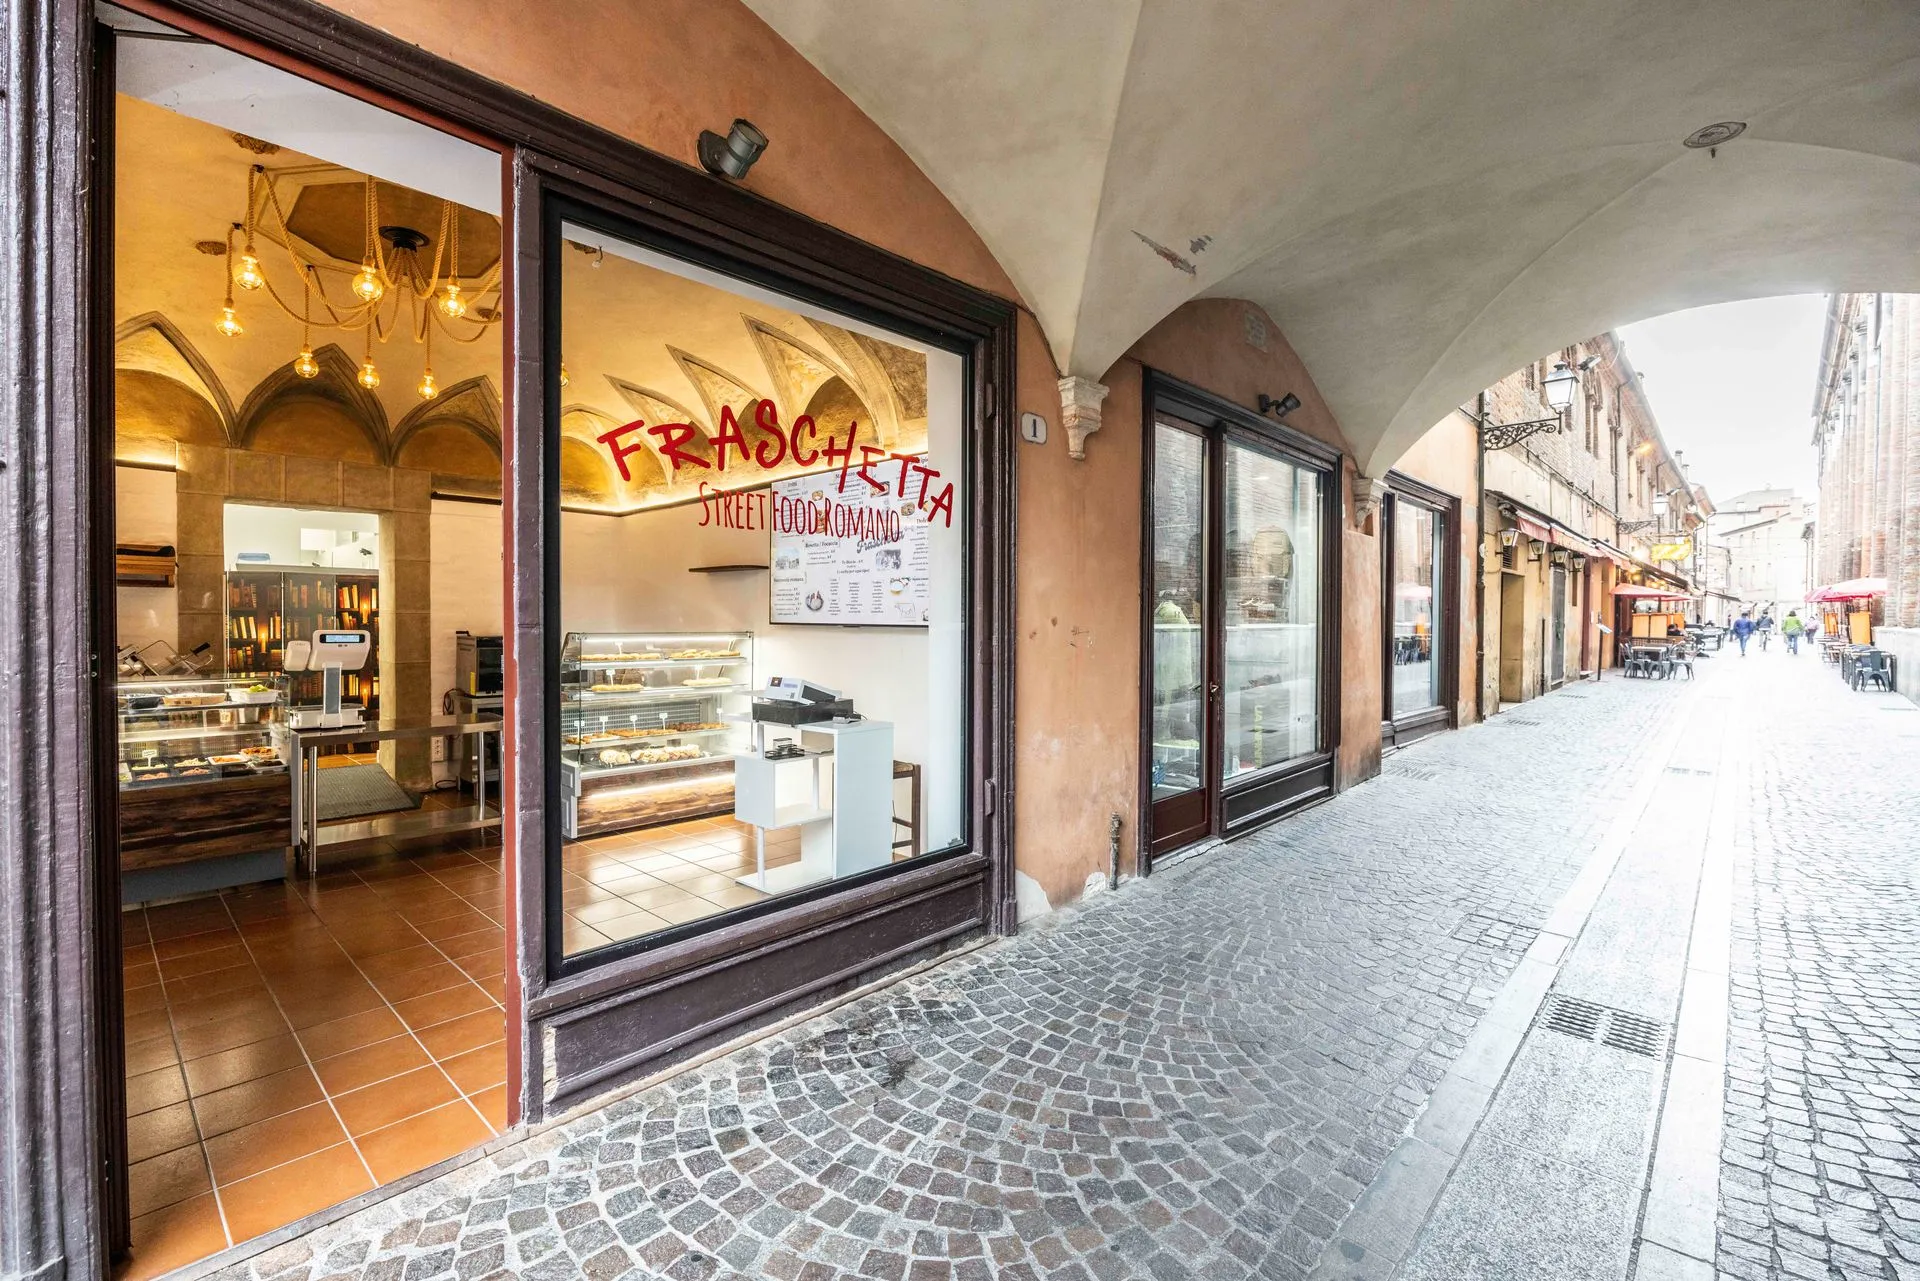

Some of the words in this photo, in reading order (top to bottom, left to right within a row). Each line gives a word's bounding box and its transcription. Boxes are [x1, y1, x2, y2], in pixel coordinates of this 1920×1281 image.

[597, 398, 955, 528] FRASCHETTA
[698, 480, 767, 530] STREET
[772, 491, 818, 535] FOOD
[824, 498, 900, 543] ROMANO
